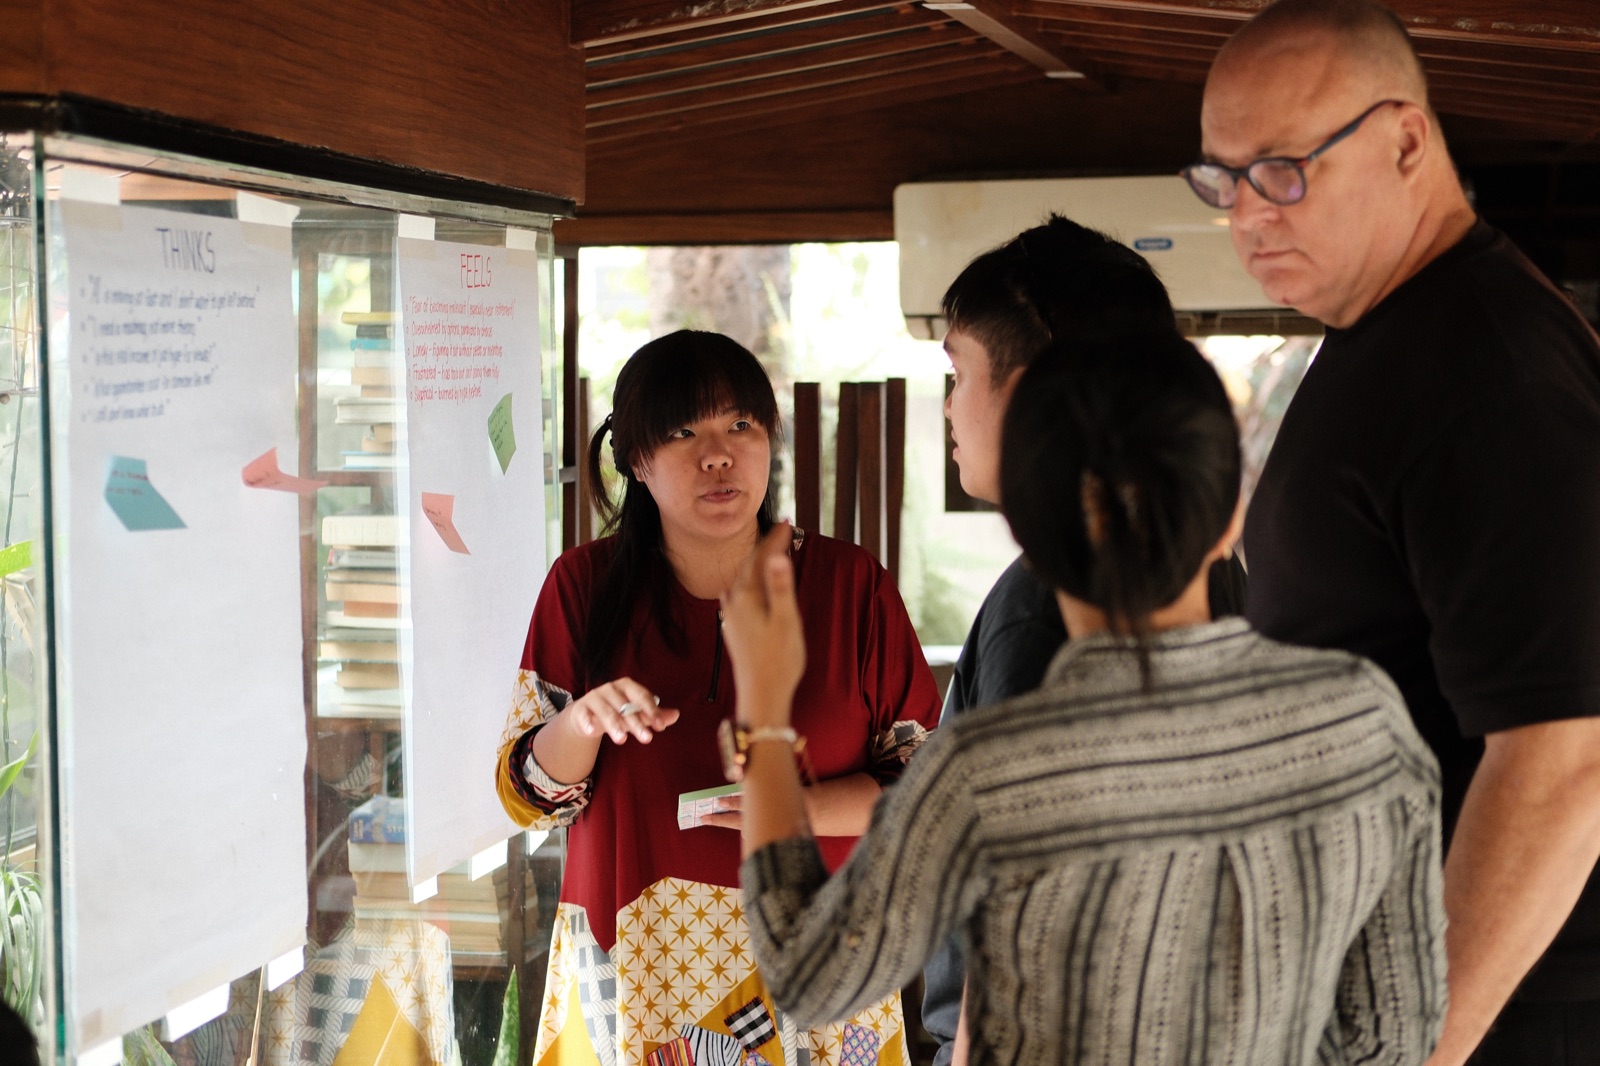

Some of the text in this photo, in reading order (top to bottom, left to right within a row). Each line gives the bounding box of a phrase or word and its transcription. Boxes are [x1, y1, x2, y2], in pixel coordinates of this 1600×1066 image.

[155, 227, 215, 274] THINKS
[460, 253, 492, 289] FEELS
[413, 341, 428, 362] Lonely
